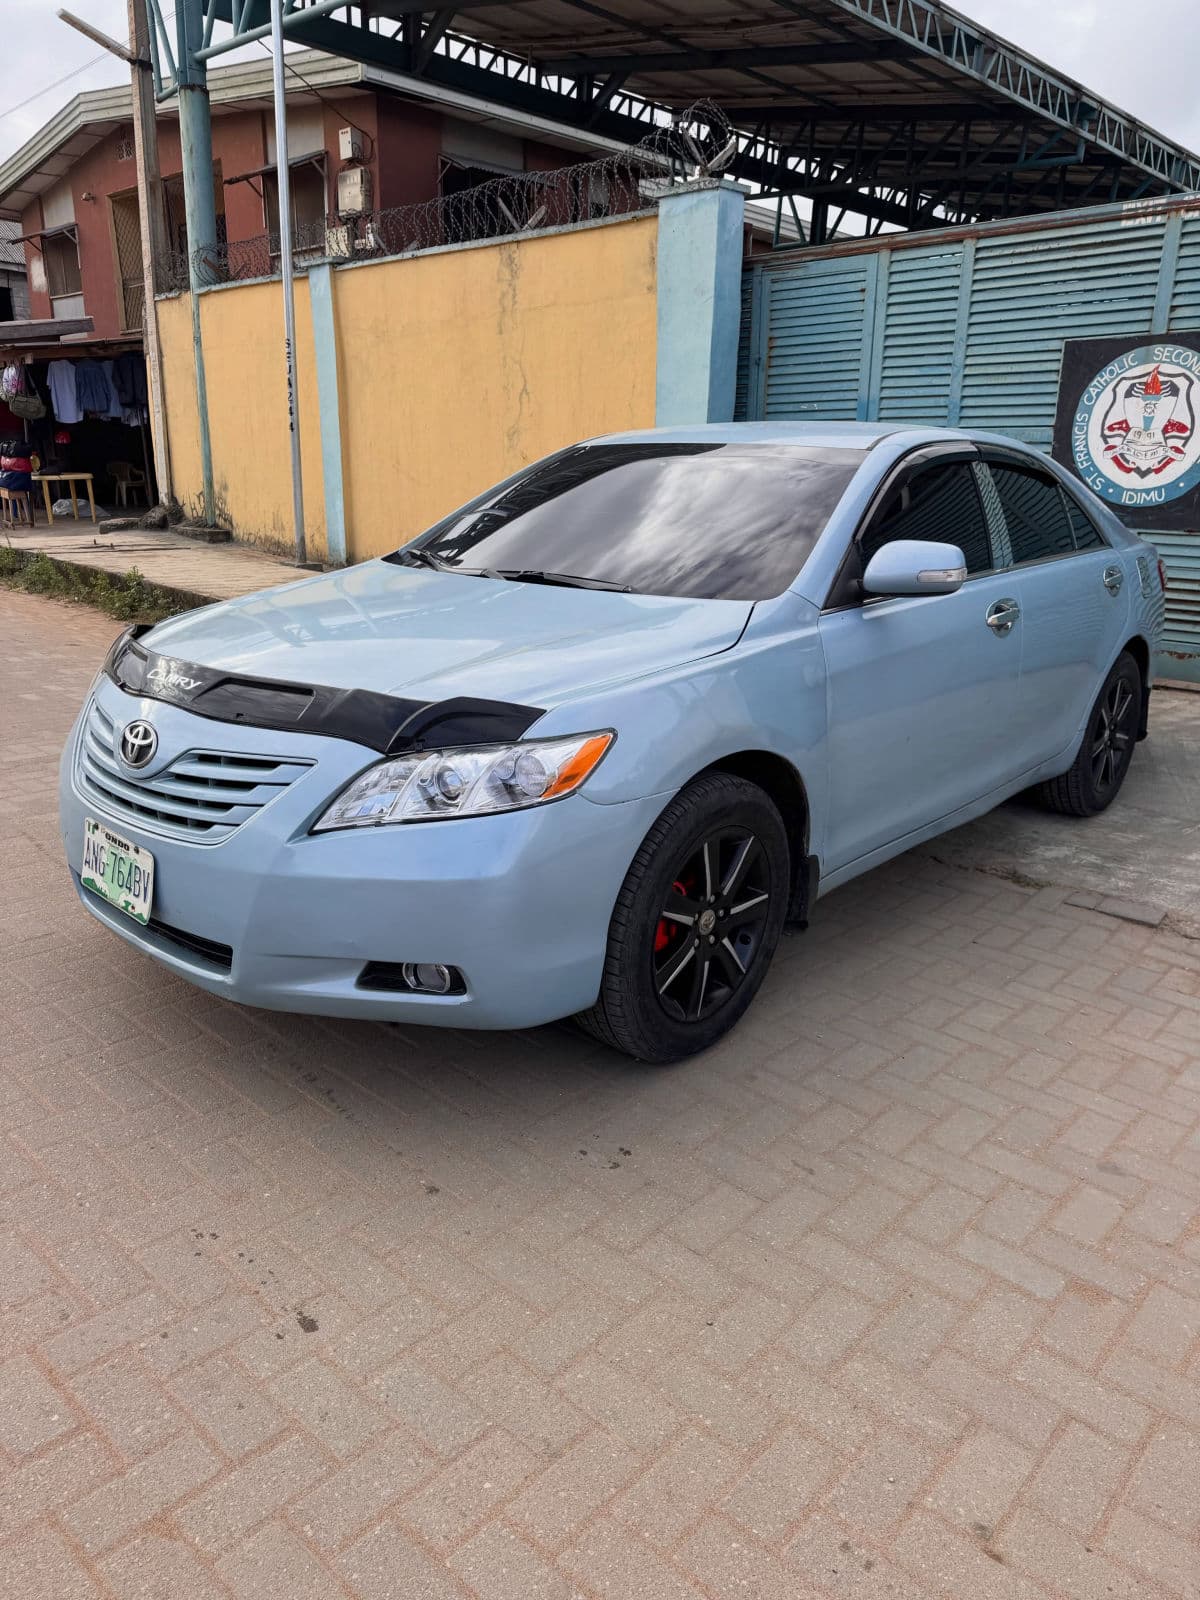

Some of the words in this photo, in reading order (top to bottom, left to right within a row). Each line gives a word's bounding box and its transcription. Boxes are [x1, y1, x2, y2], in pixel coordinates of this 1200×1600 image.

[1075, 413, 1092, 469] FRANCIS
[1084, 353, 1138, 406] CATHOLIC
[1121, 488, 1165, 504] IDIMU
[147, 670, 202, 689] CAMRY
[105, 833, 130, 851] ONDO
